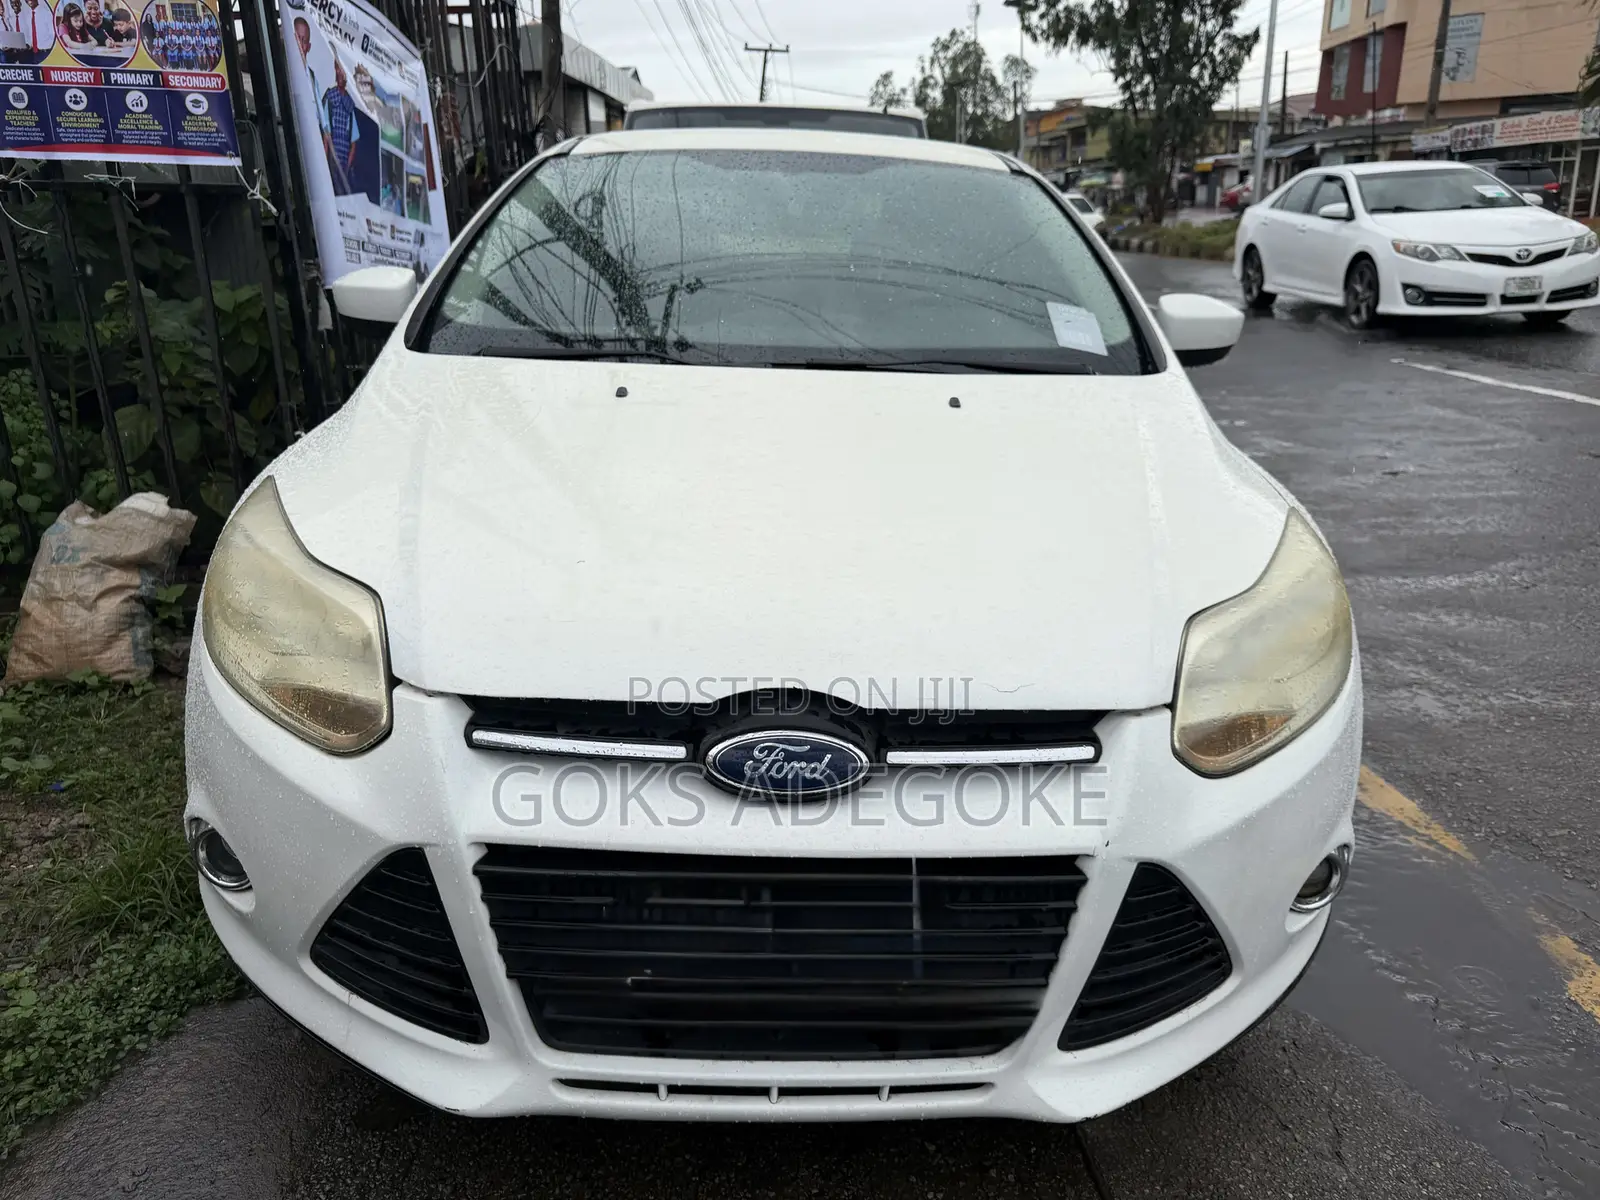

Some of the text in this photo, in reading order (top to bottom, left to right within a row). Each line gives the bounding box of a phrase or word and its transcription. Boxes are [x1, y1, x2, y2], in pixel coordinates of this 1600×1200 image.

[306, 0, 343, 23] ERCY
[0, 69, 222, 88] CRECHE NURSERY PRIMARY SECONDARY
[743, 742, 832, 779] Ford
